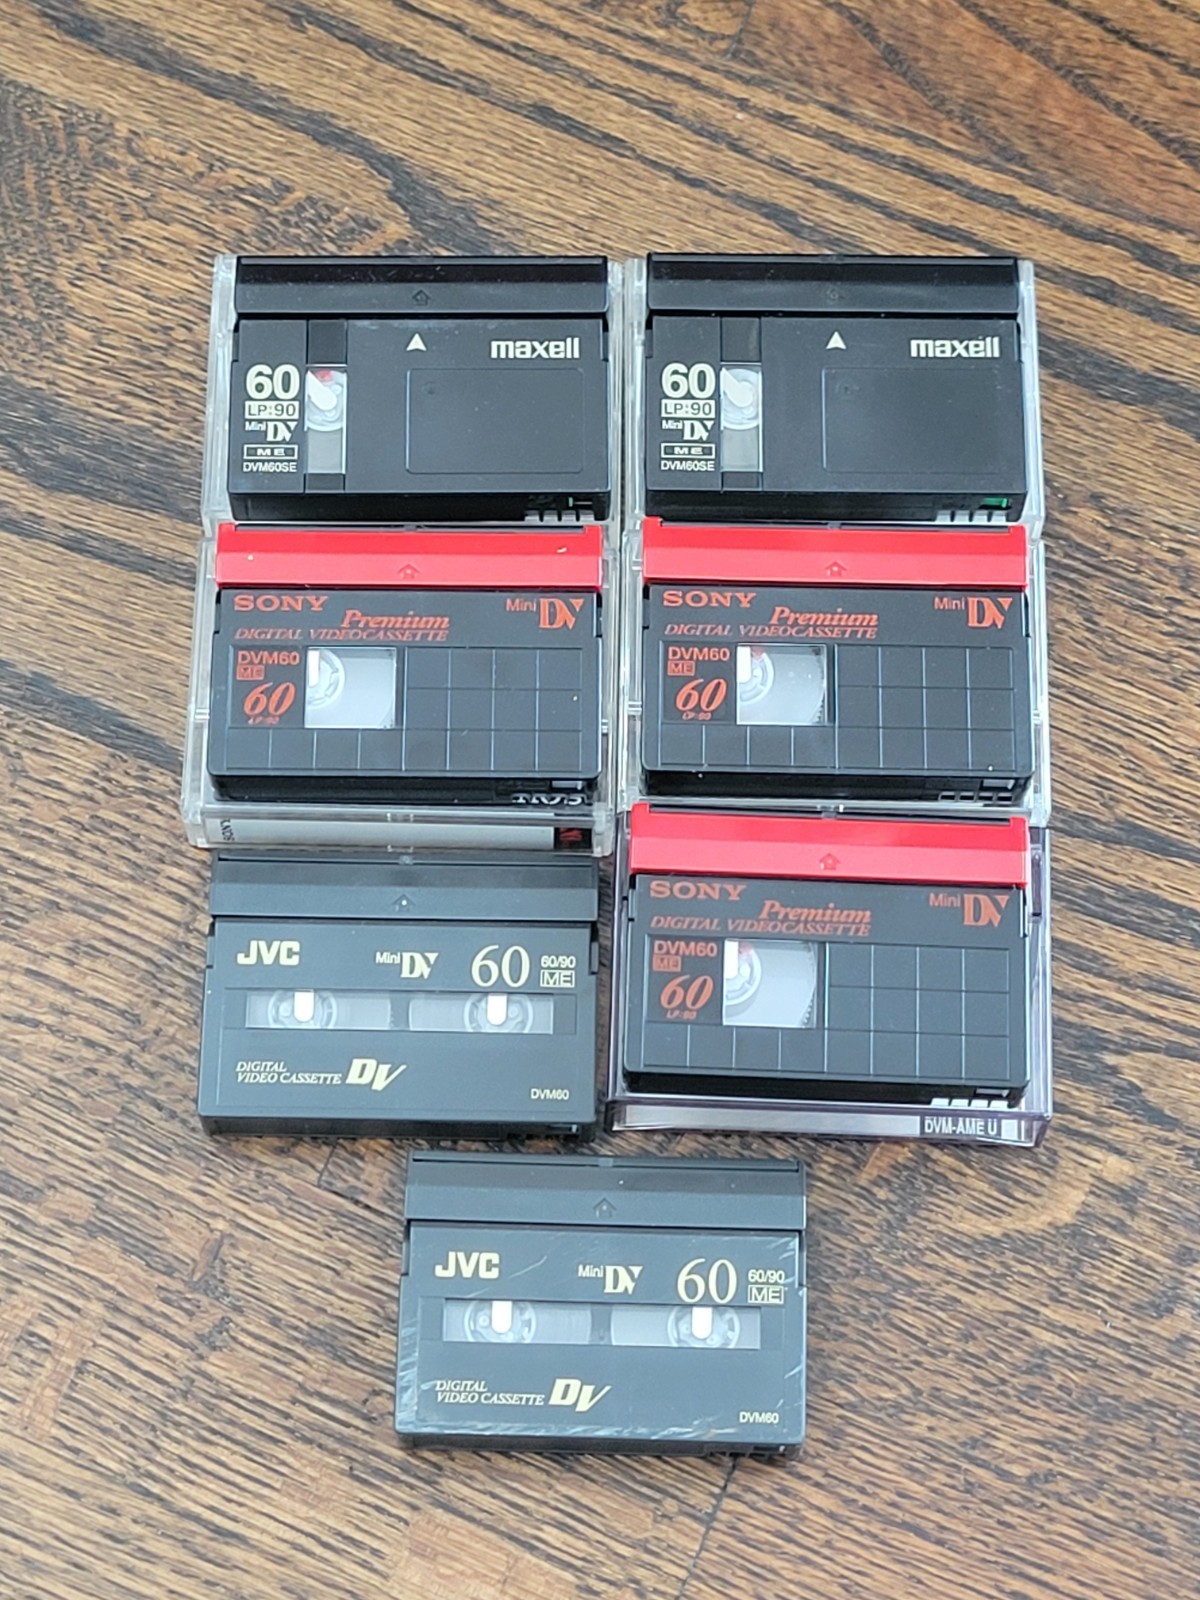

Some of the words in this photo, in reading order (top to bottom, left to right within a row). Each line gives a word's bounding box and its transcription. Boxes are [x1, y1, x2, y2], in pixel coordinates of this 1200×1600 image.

[490, 337, 580, 360] maxell
[910, 335, 1000, 359] maxell
[245, 363, 300, 400] 60
[661, 362, 716, 399] 60
[247, 402, 298, 417] LP:90
[663, 401, 714, 416] LP:90
[244, 420, 266, 432] Mini
[266, 421, 298, 442] DV
[661, 419, 683, 430] Mini
[683, 420, 715, 441] DV
[256, 448, 286, 456] ME
[673, 446, 704, 455] ME
[242, 461, 298, 473] DVM60SE
[660, 460, 716, 472] DVM60SE
[233, 594, 328, 612] SONY
[662, 590, 757, 608] SONY
[340, 609, 451, 631] Premium
[505, 598, 537, 613] Mini
[538, 598, 585, 631] DV
[768, 605, 880, 627] Premium
[934, 596, 965, 611] Mini
[966, 597, 1013, 630] DV
[233, 628, 303, 641] DIGITAL
[309, 628, 450, 642] VIDEOCASSETTE
[664, 623, 733, 637] DIGITAL
[739, 624, 879, 640] VIDEOCASSETTE
[237, 650, 300, 666] DVM60
[667, 645, 731, 661] DVM60
[670, 661, 694, 676] ME
[243, 681, 297, 717] 60
[675, 678, 728, 712] 60
[649, 880, 746, 900] SONY
[758, 900, 872, 924] Premium
[928, 891, 961, 909] Mini
[963, 893, 1009, 928] DV
[650, 914, 721, 932] DIGITAL
[727, 916, 871, 937] VIDEOCASSETTE
[236, 939, 301, 966] JVC
[654, 939, 718, 957] DVM60
[375, 951, 400, 965] Mini
[400, 952, 439, 979] DV
[471, 944, 531, 988] 60
[540, 955, 577, 969] 60/90
[543, 972, 574, 987] ME
[660, 974, 715, 1011] 60
[235, 1060, 288, 1074] DIGITAL
[345, 1057, 408, 1091] DV
[236, 1072, 279, 1085] VIDEO
[279, 1073, 342, 1086] CASSETTE
[530, 1088, 570, 1101] DVM60
[924, 1116, 985, 1135] DVM-AME
[988, 1118, 997, 1136] U
[434, 1250, 500, 1280] JVC
[577, 1264, 604, 1279] Mini
[604, 1265, 644, 1295] DV
[676, 1258, 738, 1304] 60
[747, 1269, 786, 1285] 60/90
[751, 1286, 782, 1303] ME
[435, 1379, 488, 1393] DIGITAL
[548, 1377, 612, 1412] DV
[436, 1391, 479, 1405] VIDEO
[480, 1391, 545, 1406] CASSETTE
[738, 1410, 780, 1424] DVM60
